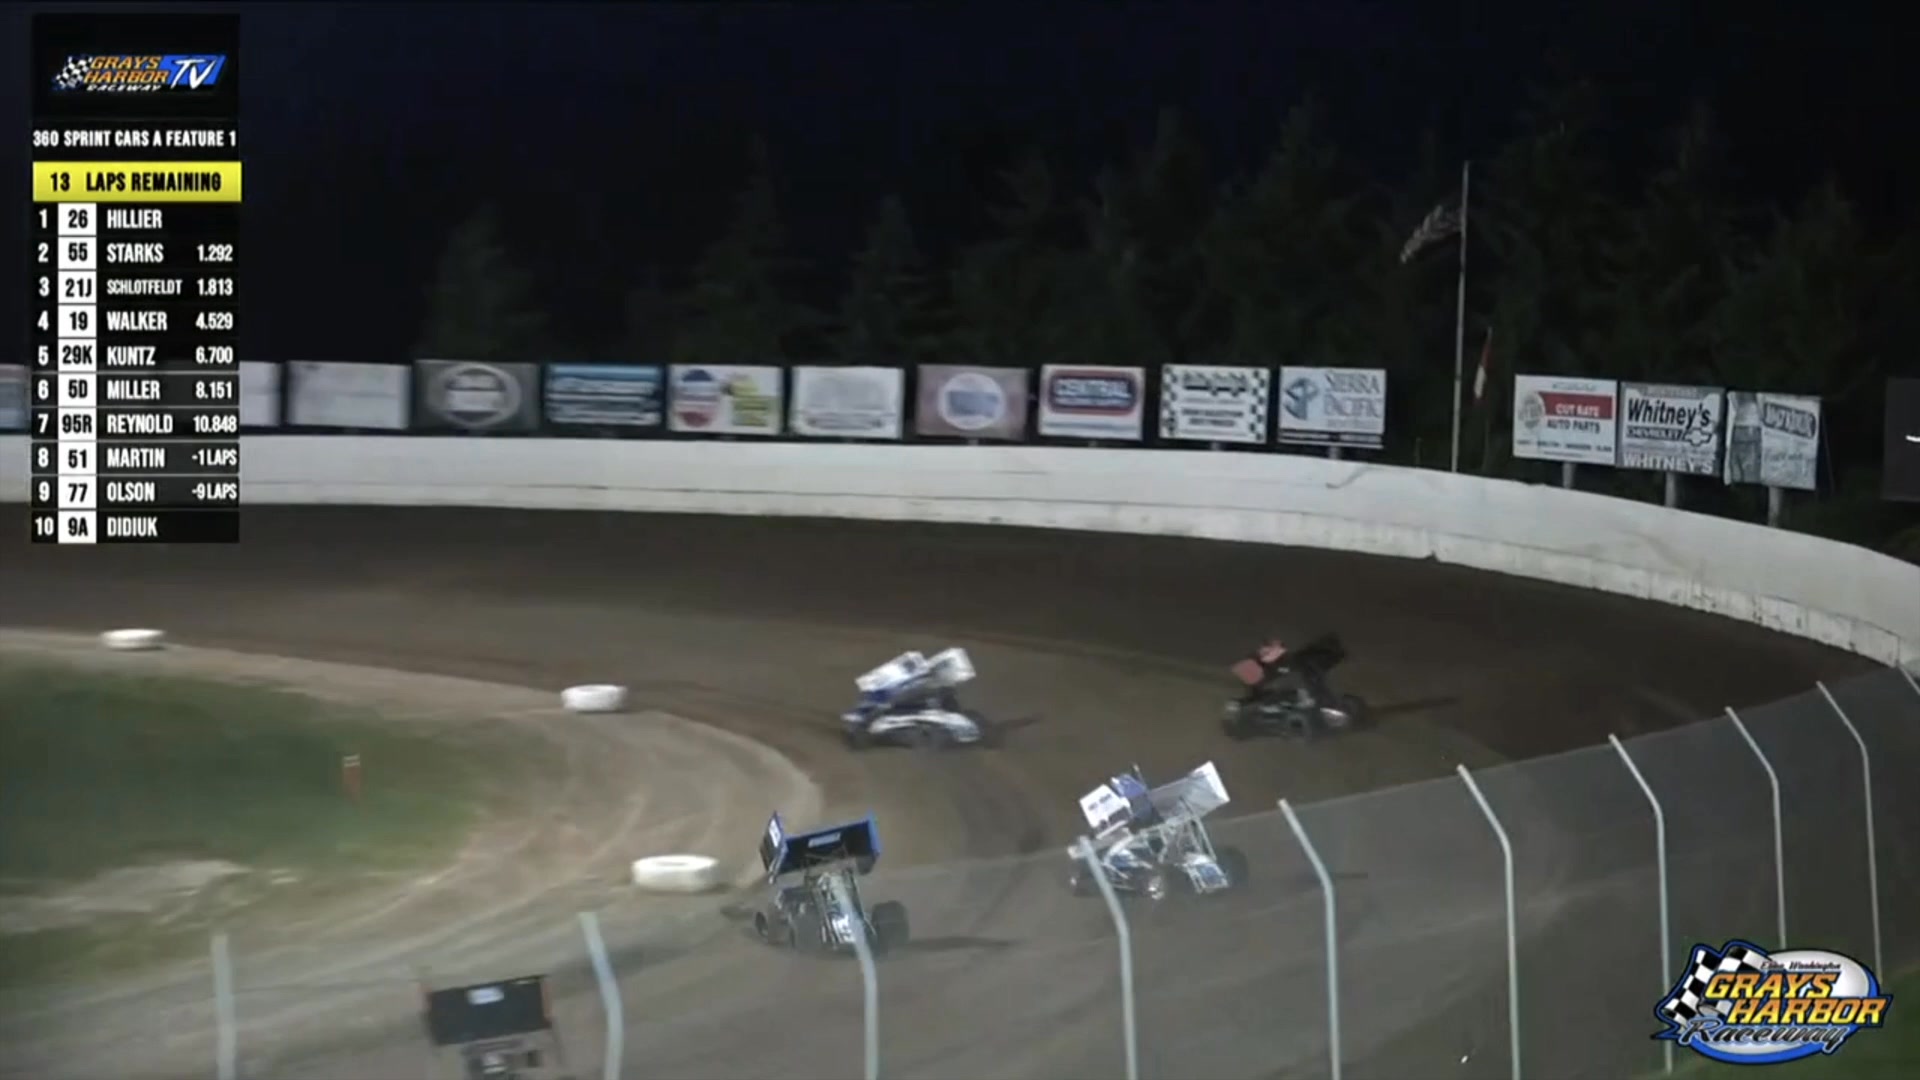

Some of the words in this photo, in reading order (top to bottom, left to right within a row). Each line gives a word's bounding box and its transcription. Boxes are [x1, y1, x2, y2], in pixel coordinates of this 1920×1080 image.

[1627, 397, 1711, 431] Whitney's
[1547, 419, 1571, 430] AUTO
[1573, 420, 1600, 434] PARTS
[1623, 451, 1713, 475] WHITNEY'S
